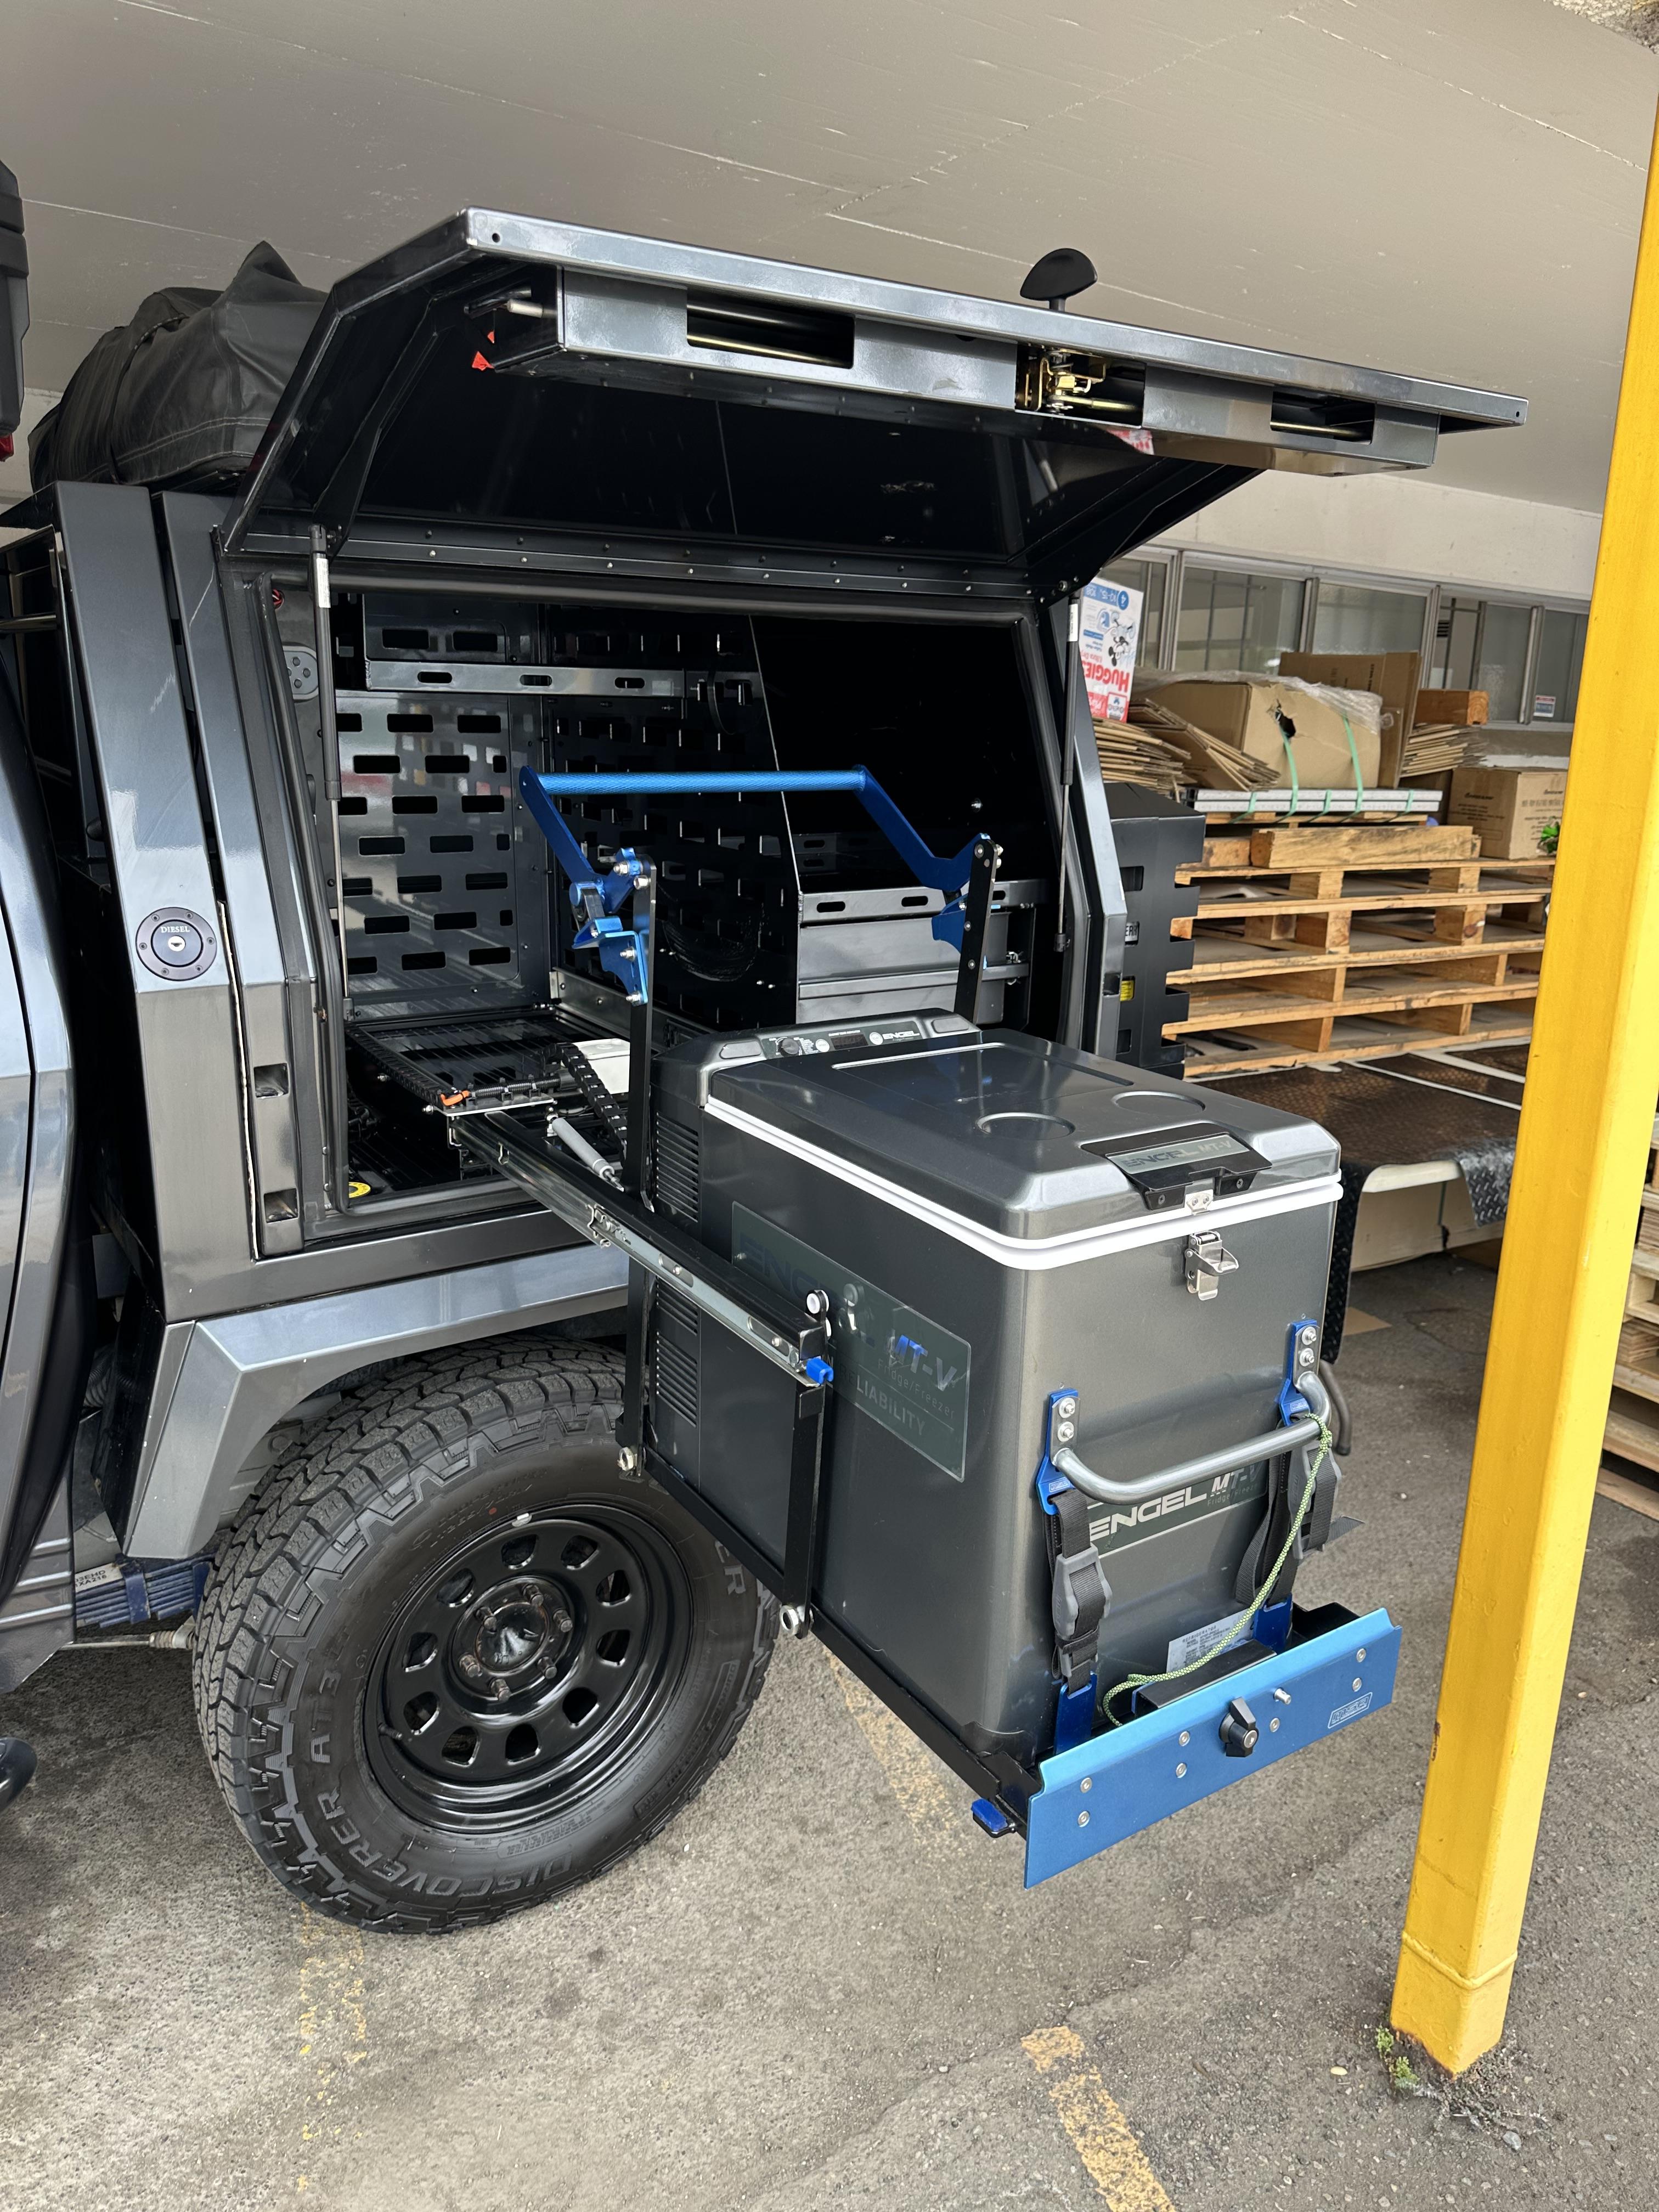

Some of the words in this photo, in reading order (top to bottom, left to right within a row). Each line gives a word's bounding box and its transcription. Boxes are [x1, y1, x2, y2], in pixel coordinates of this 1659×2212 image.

[882, 1030, 920, 1040] ENGEL
[1122, 1149, 1200, 1167] ENGEL
[1089, 1486, 1207, 1542] ENGEL
[317, 1787, 573, 1897] DISCOVERER
